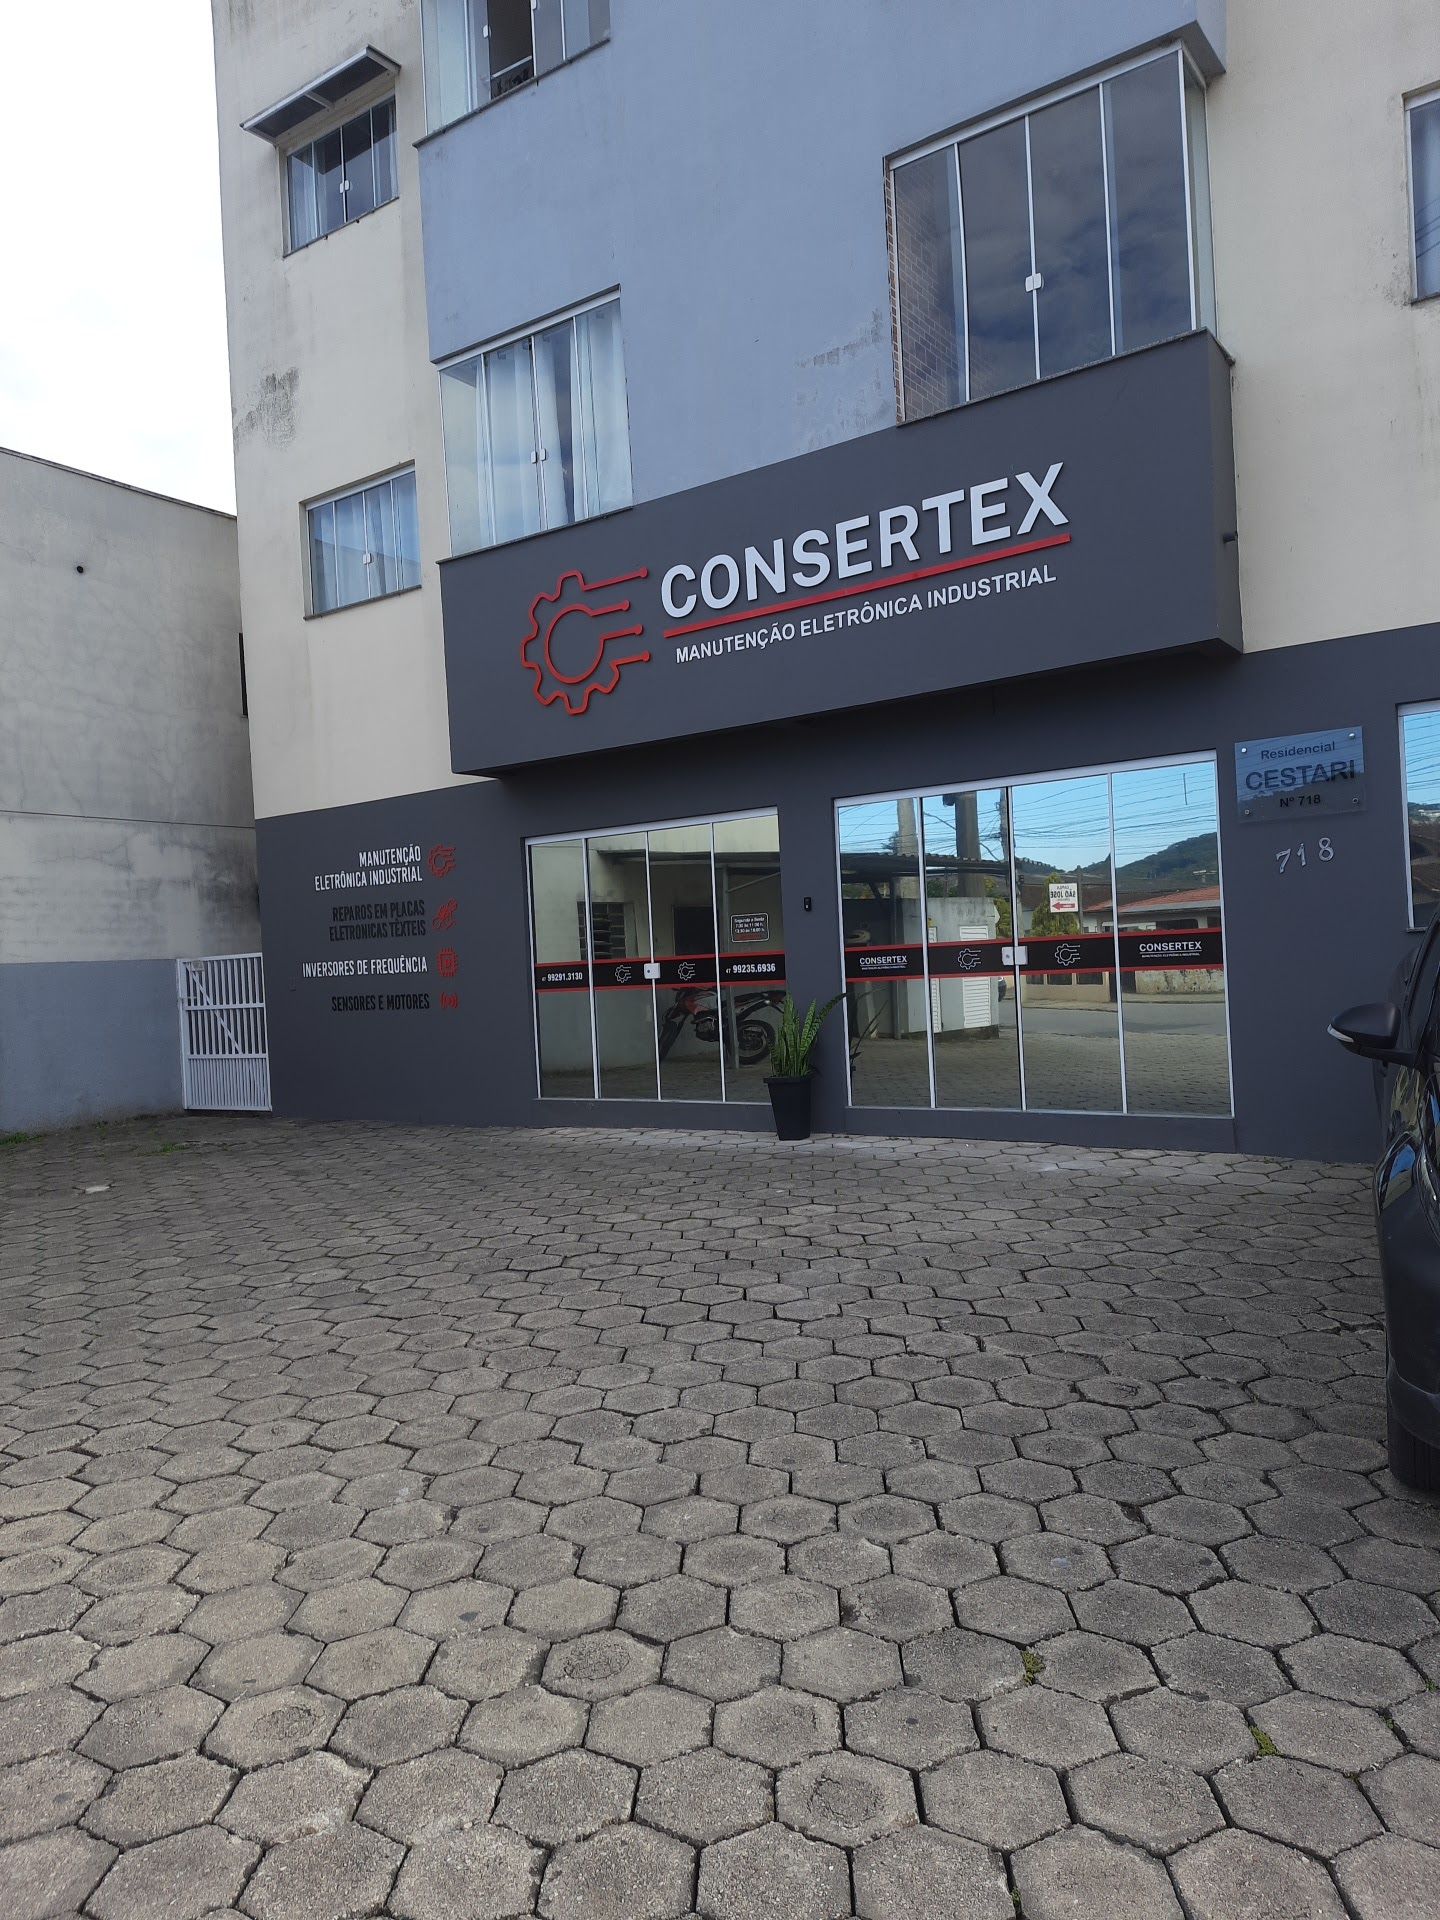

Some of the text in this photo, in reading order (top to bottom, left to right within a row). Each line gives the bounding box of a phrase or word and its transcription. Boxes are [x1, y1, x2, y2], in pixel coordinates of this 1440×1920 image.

[660, 461, 1070, 619] CONSERTEX
[675, 564, 1057, 663] MANUTENÇÃO ELETRÔNICA INDUSTRIAL
[1260, 741, 1335, 760] Residencial
[1245, 760, 1355, 791] CESTARI
[1299, 794, 1321, 806] 718
[358, 844, 421, 867] MANUTENÇÃO
[1275, 837, 1334, 874] 718
[314, 866, 423, 891] ELETRÔNICA INDUSTRIAL
[332, 900, 425, 922] REPAROS EM PLACAS
[389, 919, 426, 937] TÊXTEIS
[1139, 941, 1202, 952] CONSERTEX
[302, 955, 428, 978] INVERSORES DE FREQUÊNCIA
[732, 963, 776, 974] 99235.6936
[859, 955, 908, 965] CONSERTEX
[331, 993, 430, 1012] SENSORES E MOTORES
